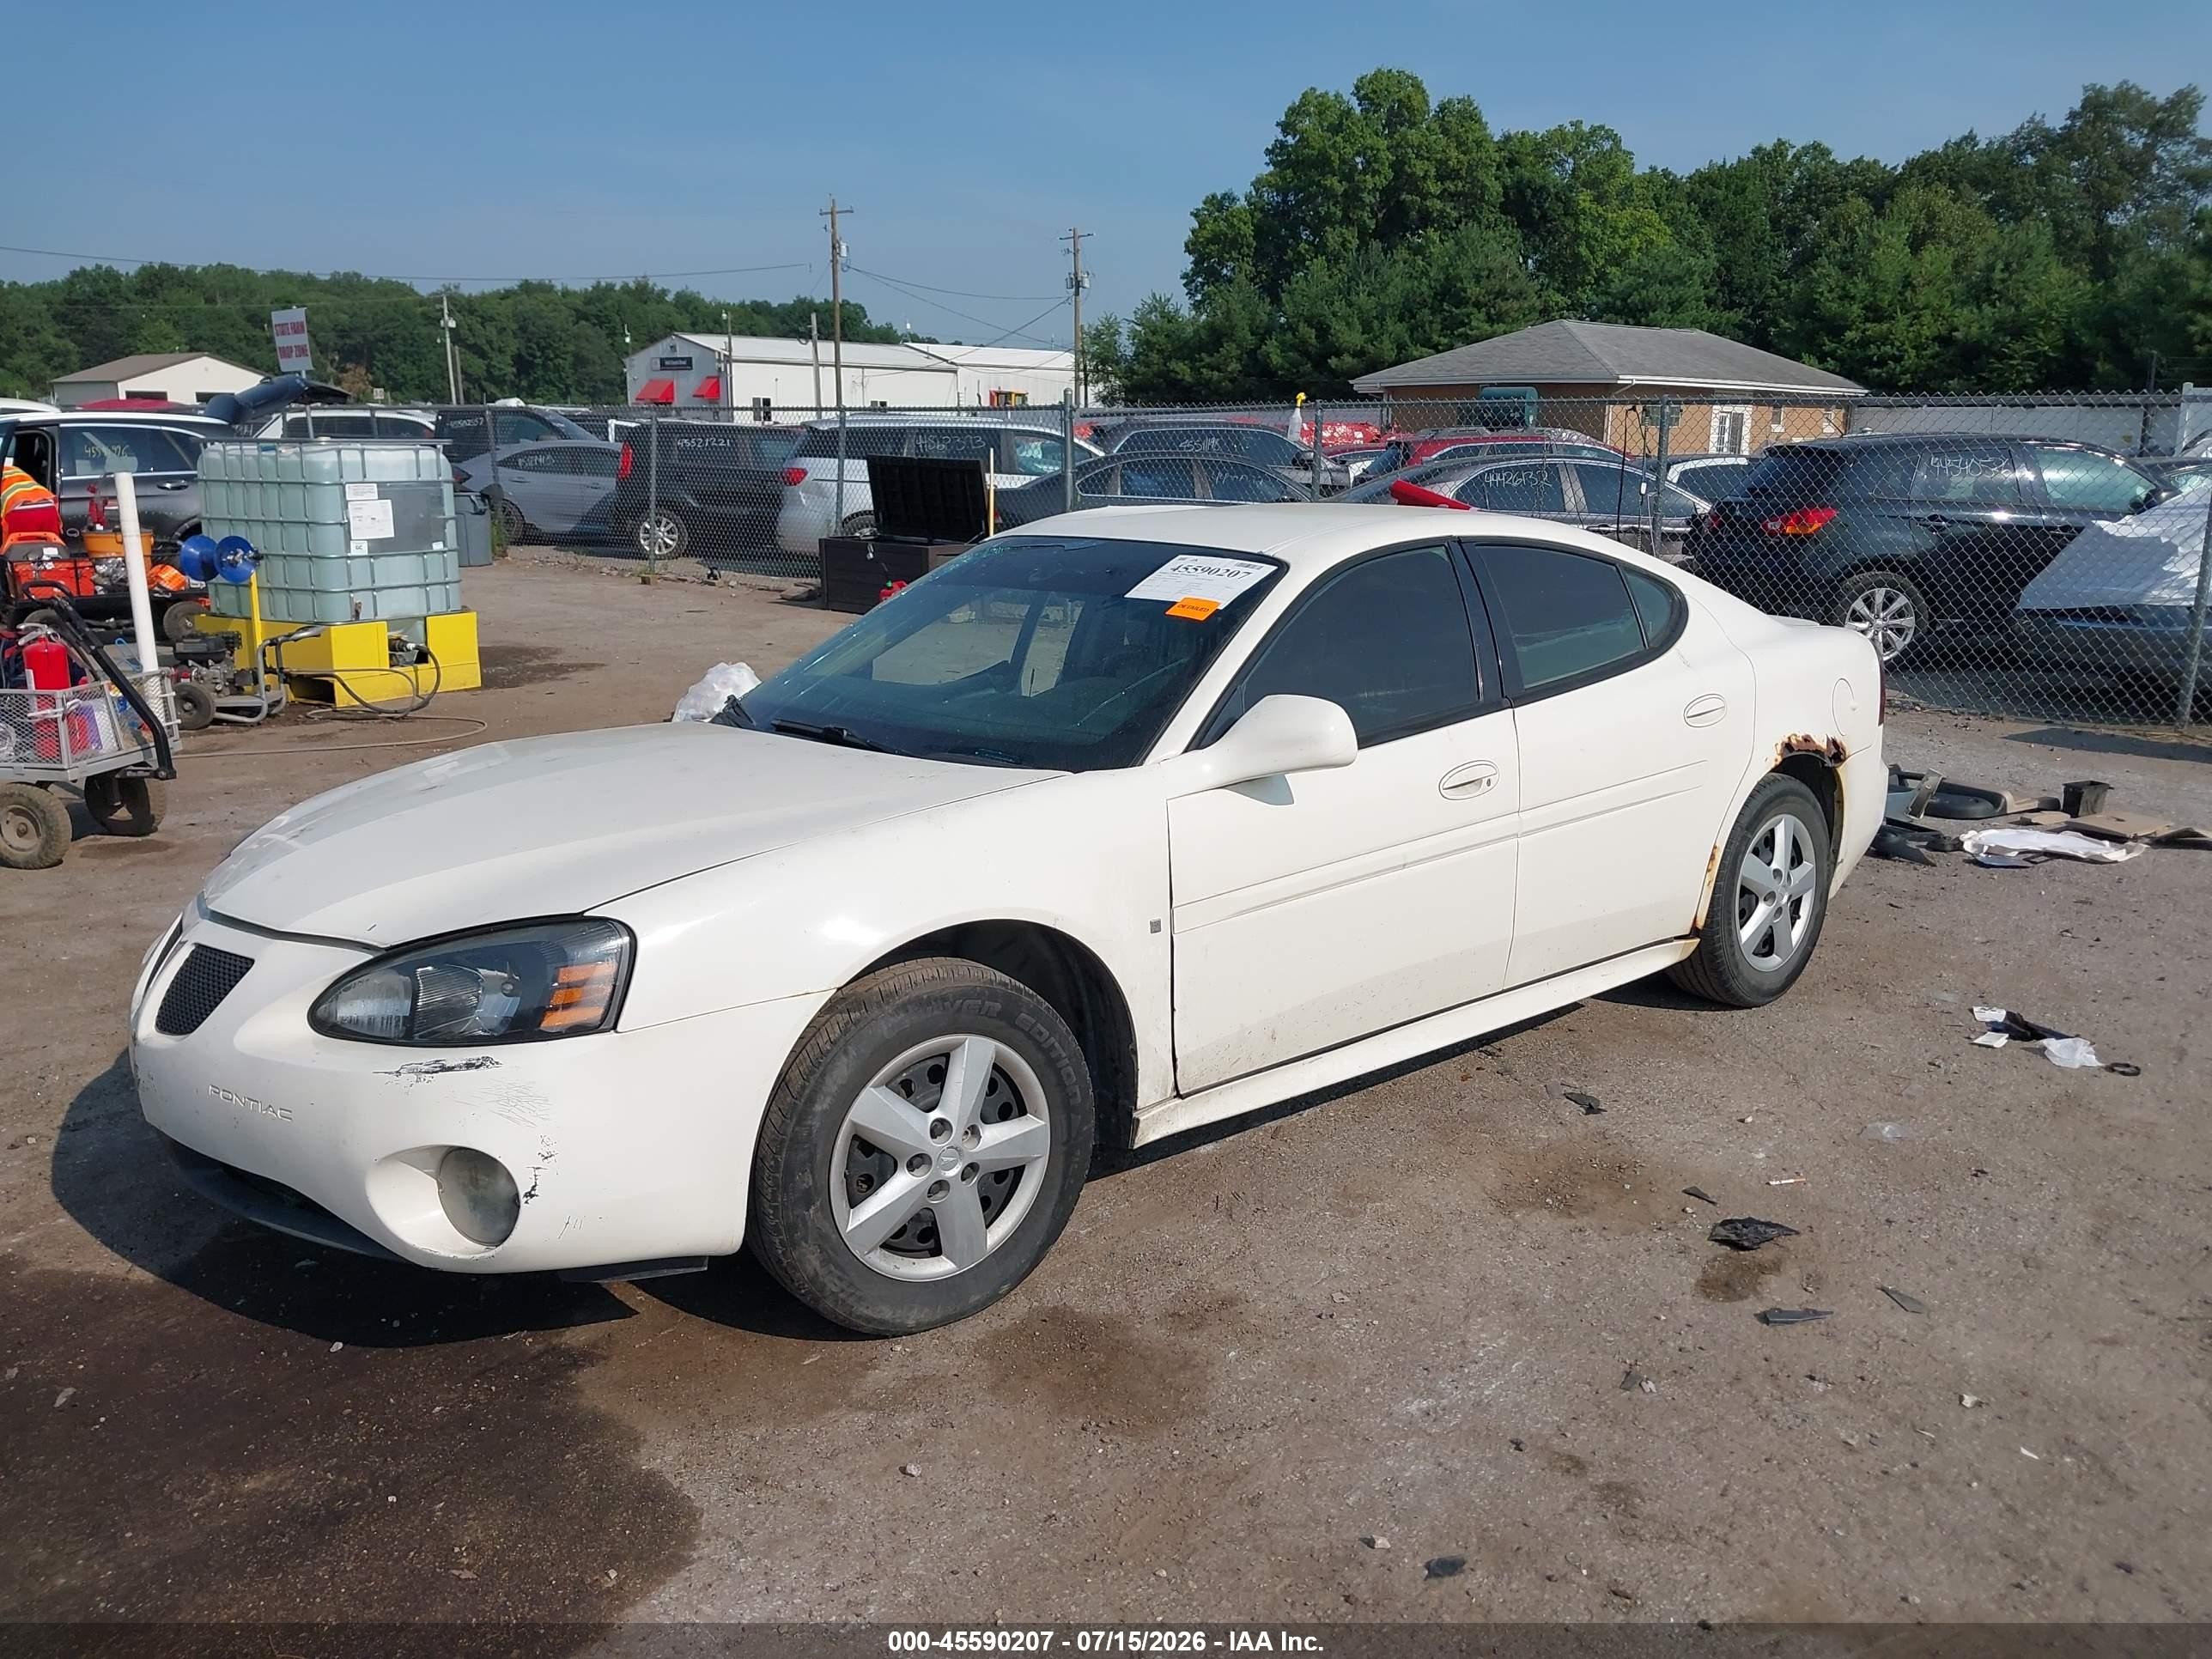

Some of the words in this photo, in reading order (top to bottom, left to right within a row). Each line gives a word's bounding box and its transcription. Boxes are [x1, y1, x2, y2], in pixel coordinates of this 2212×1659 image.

[1170, 563, 1254, 580] 45590207
[1176, 603, 1210, 613] DETAILED
[209, 1084, 293, 1122] PONTIAC
